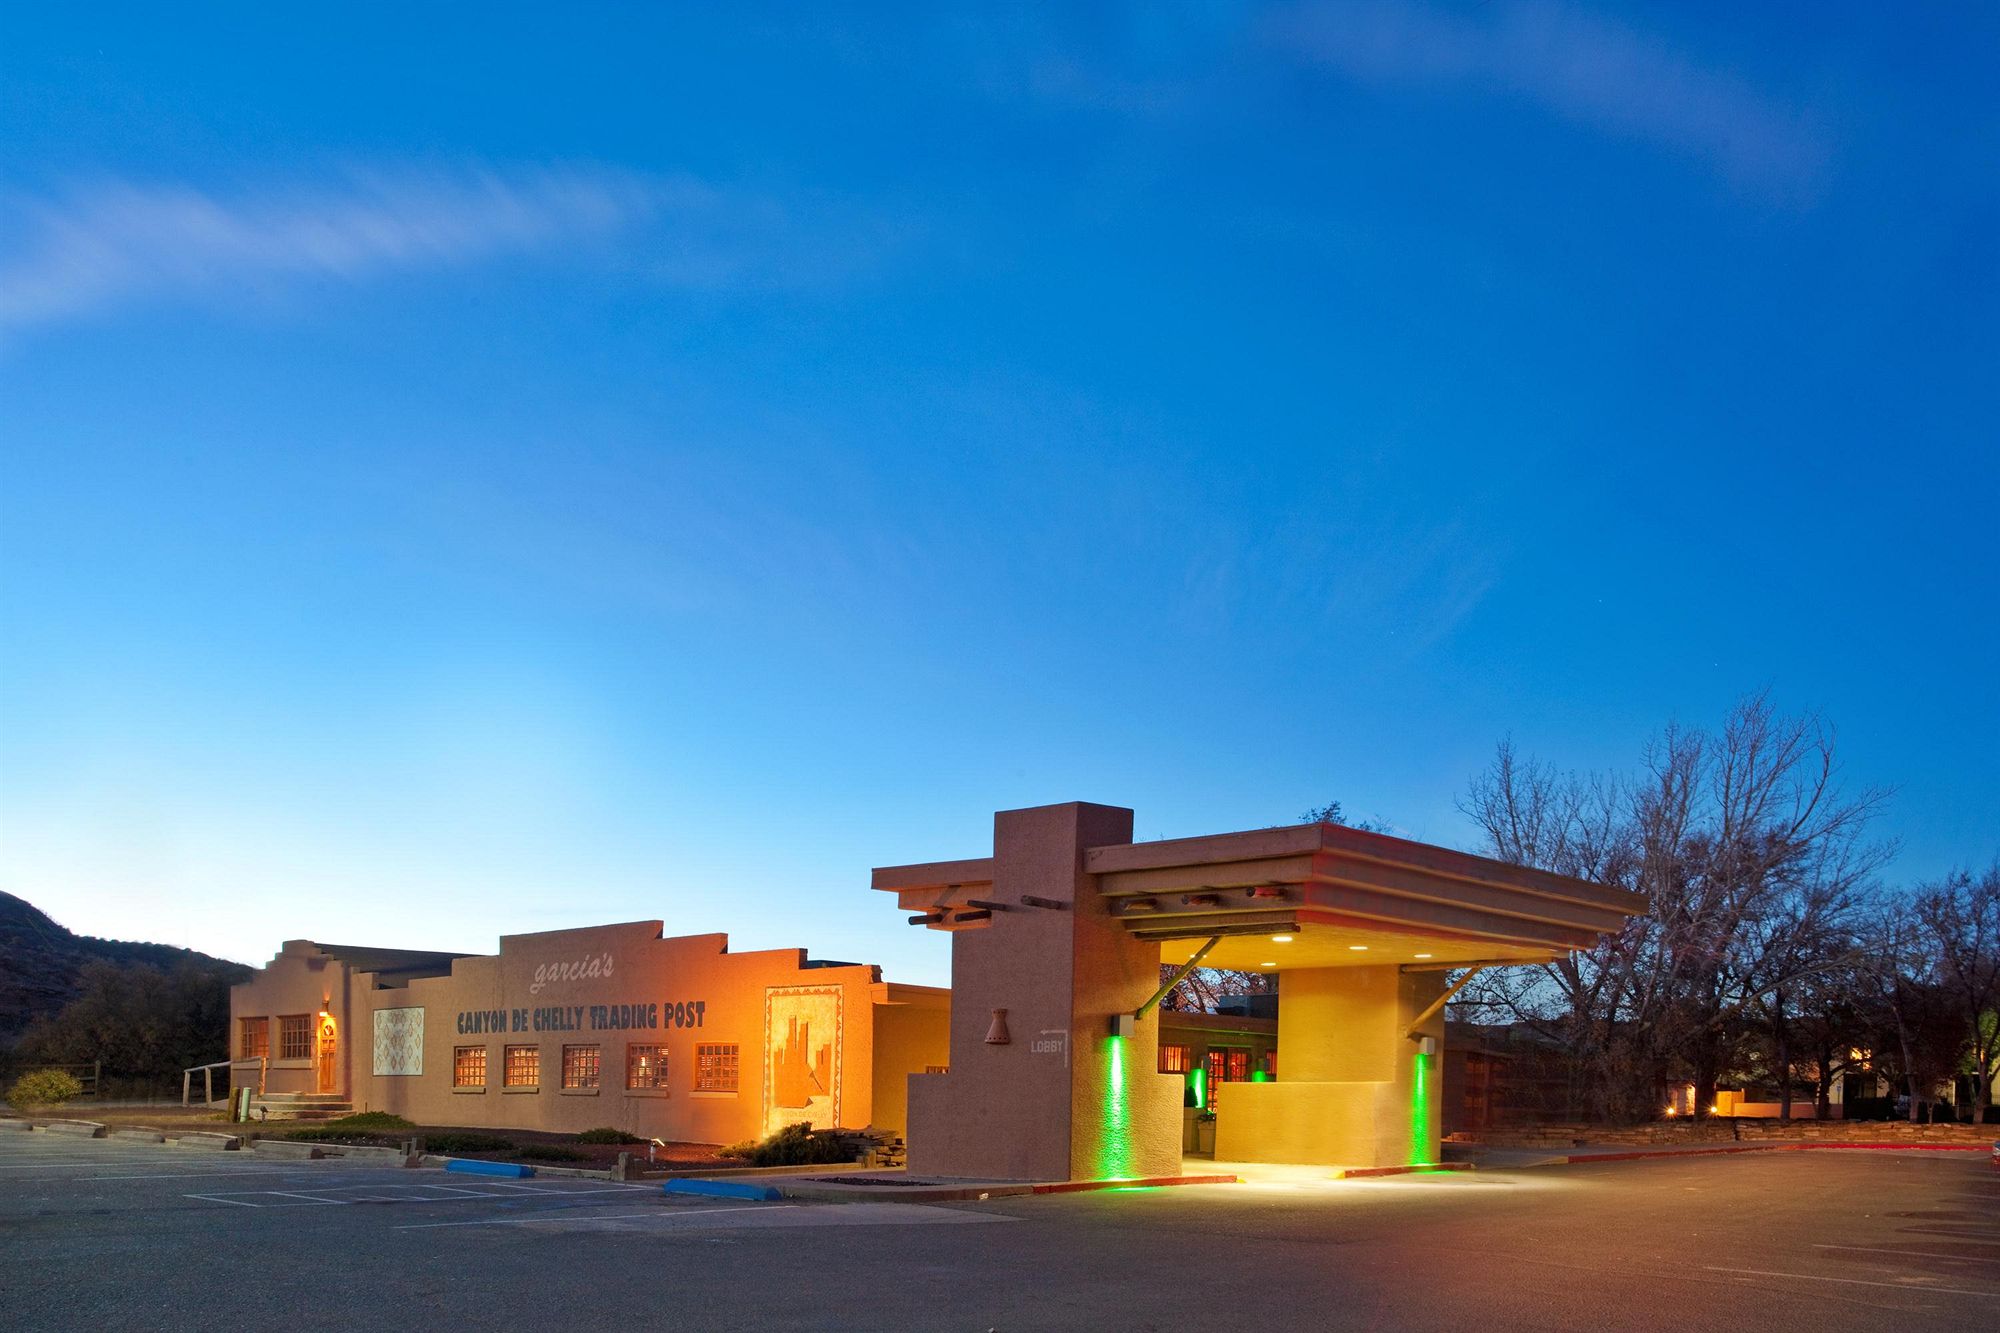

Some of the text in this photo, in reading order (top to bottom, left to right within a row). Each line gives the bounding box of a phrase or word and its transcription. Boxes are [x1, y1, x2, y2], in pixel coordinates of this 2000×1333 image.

[530, 952, 615, 994] garcia's
[457, 1000, 705, 1034] CANYON DE CHELLY TRADING POST
[1031, 1040, 1062, 1052] LOBBY
